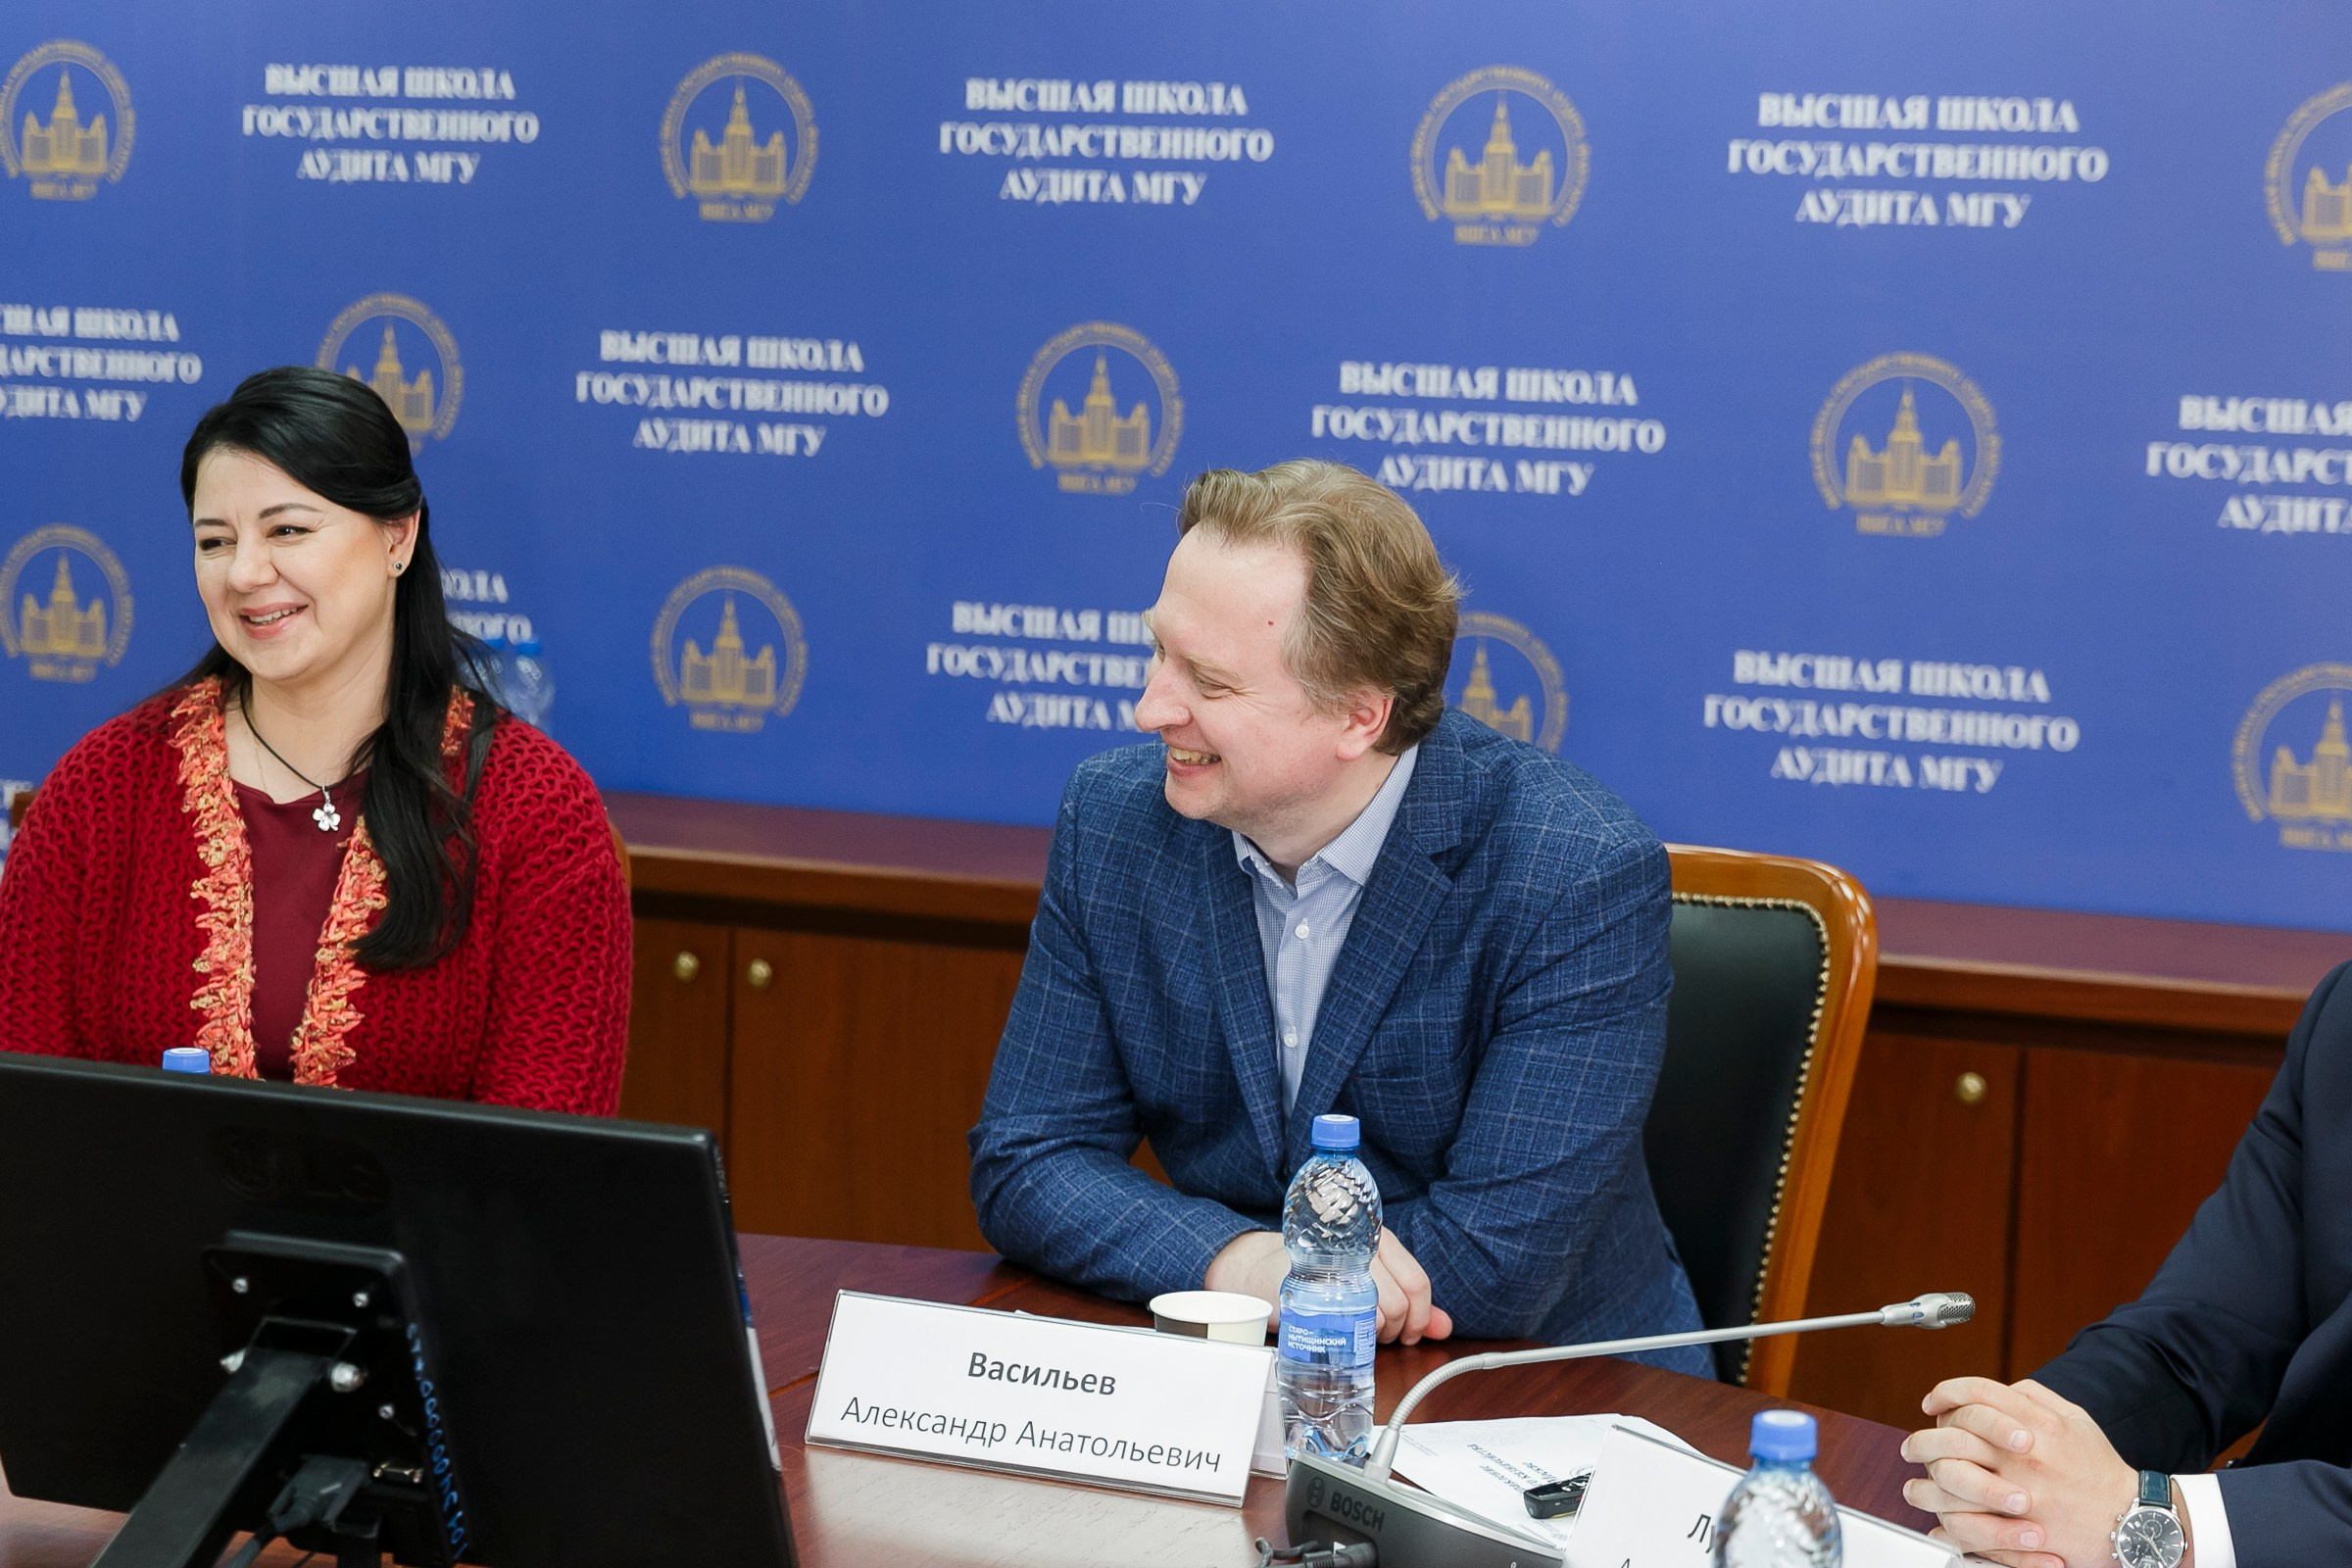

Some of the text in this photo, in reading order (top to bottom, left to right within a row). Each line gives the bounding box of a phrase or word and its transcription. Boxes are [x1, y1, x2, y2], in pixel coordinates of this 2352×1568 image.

[266, 64, 515, 100] ВЫСШАЯ ШКОЛА
[965, 77, 1248, 116] ВЫСШАЯ ШКОЛА
[243, 105, 539, 143] ГОСУДАРСТВЕННОГО
[1758, 93, 2079, 132] ВЫСШАЯ ШКОЛА
[940, 122, 1274, 162] ГОСУДАРСТВЕННОГО
[1728, 139, 2109, 181] ГОСУДАРСТВЕННОГО
[298, 148, 479, 183] АУДИТА МГУ
[1001, 168, 1206, 205] АУДИТА МГУ
[1795, 189, 2031, 227] АУДИТА МГУ
[74, 307, 179, 342] ШКОЛА
[600, 329, 864, 372] ВЫСШАЯ ШКОЛА
[576, 371, 889, 416] ГОСУДАРСТВЕННОГО
[1340, 361, 1639, 406] ВЫСШАЯ ШКОЛА
[84, 389, 147, 421] МГУ
[633, 417, 826, 457] АУДИТА МГУ
[1311, 405, 1666, 453] ГОСУДАРСТВЕННОГО
[1378, 454, 1593, 495] АУДИТА МГУ
[953, 601, 1101, 642] ВЫСШАЯ
[1734, 650, 2050, 703] ВЫСШАЯ ШКОЛА
[987, 691, 1111, 730] АУДИТА
[1703, 694, 2080, 752] ГОСУДАРСТВЕННОГО
[1771, 747, 2002, 793] АУДИТА МГУ
[1288, 1334, 1347, 1347] МЫТИЩИНСКИЙ
[1288, 1342, 1326, 1353] ИСТОЧНИК
[967, 1350, 1116, 1396] Васильев
[841, 1396, 1222, 1473] Александр Анатольевич
[1330, 1492, 1386, 1532] BOSCH
